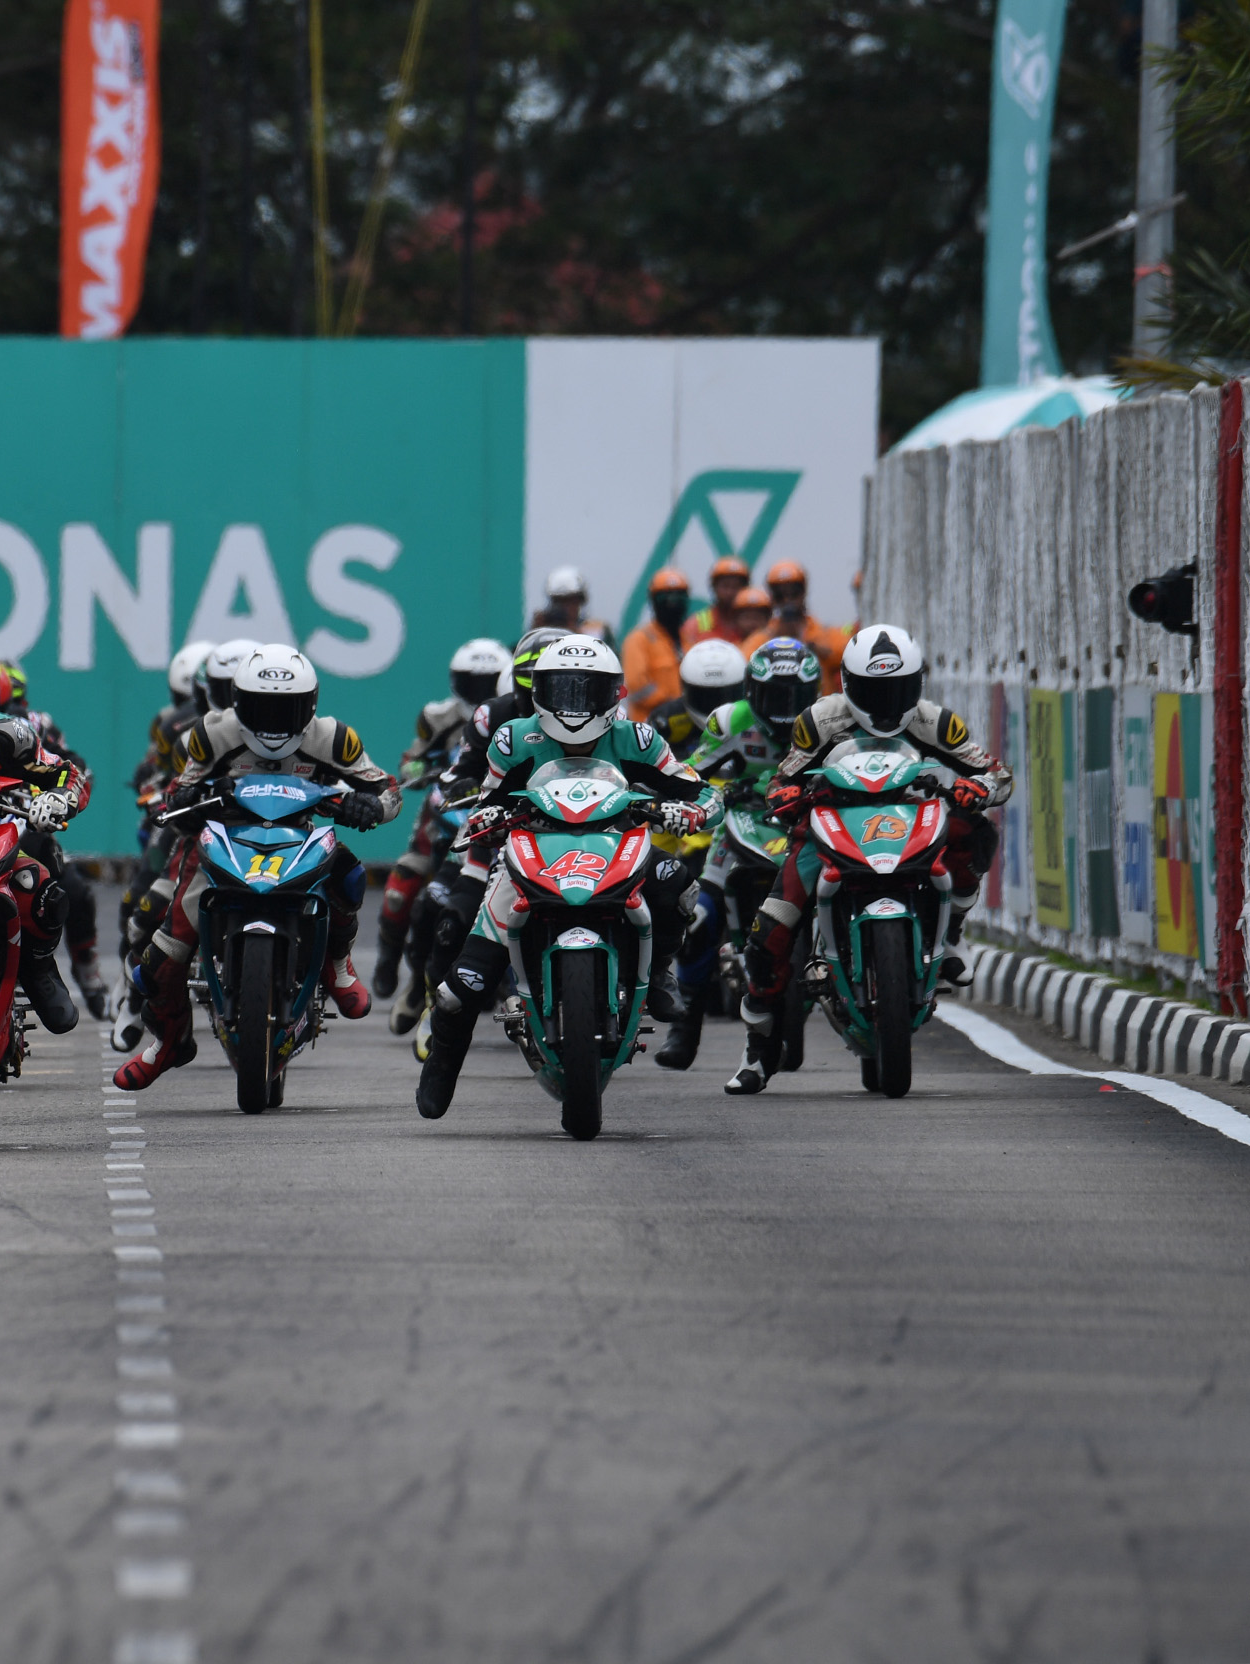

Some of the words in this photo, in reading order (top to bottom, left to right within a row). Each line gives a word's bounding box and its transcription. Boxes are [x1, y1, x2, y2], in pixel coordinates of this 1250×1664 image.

[561, 646, 595, 657] KYT
[261, 669, 293, 680] KYT
[240, 784, 284, 794] AHM
[860, 814, 908, 845] 13
[245, 854, 286, 880] 11
[539, 850, 608, 881] 42
